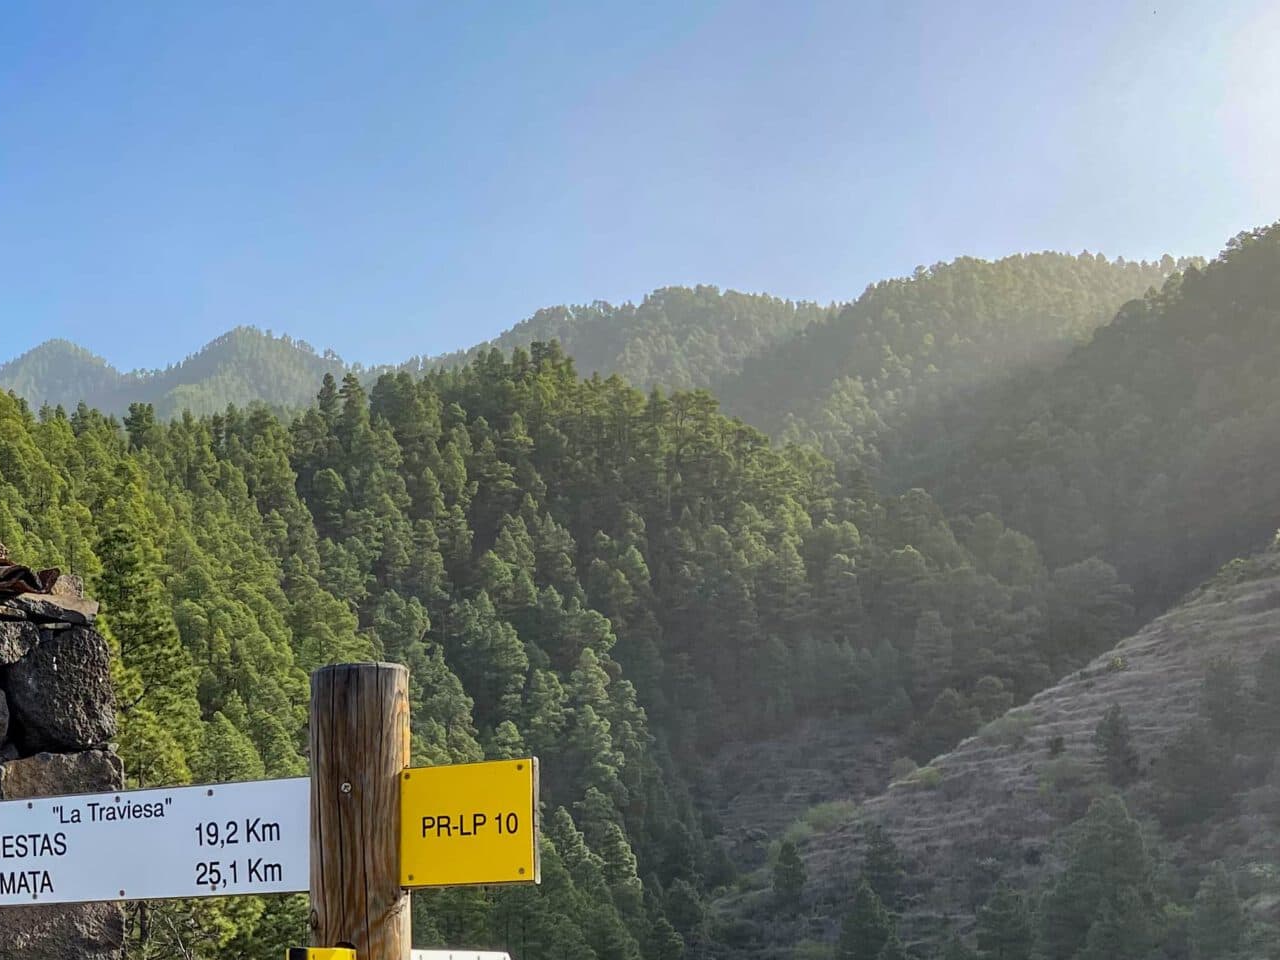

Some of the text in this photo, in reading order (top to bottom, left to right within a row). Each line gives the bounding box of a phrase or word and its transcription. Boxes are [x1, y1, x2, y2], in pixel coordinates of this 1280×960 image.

[52, 798, 173, 824] "La Traviesa"
[195, 819, 281, 849] 19,2 Km
[422, 813, 519, 838] PR-LP 10
[0, 871, 54, 894] MATA
[195, 859, 283, 889] 25,1 Km
